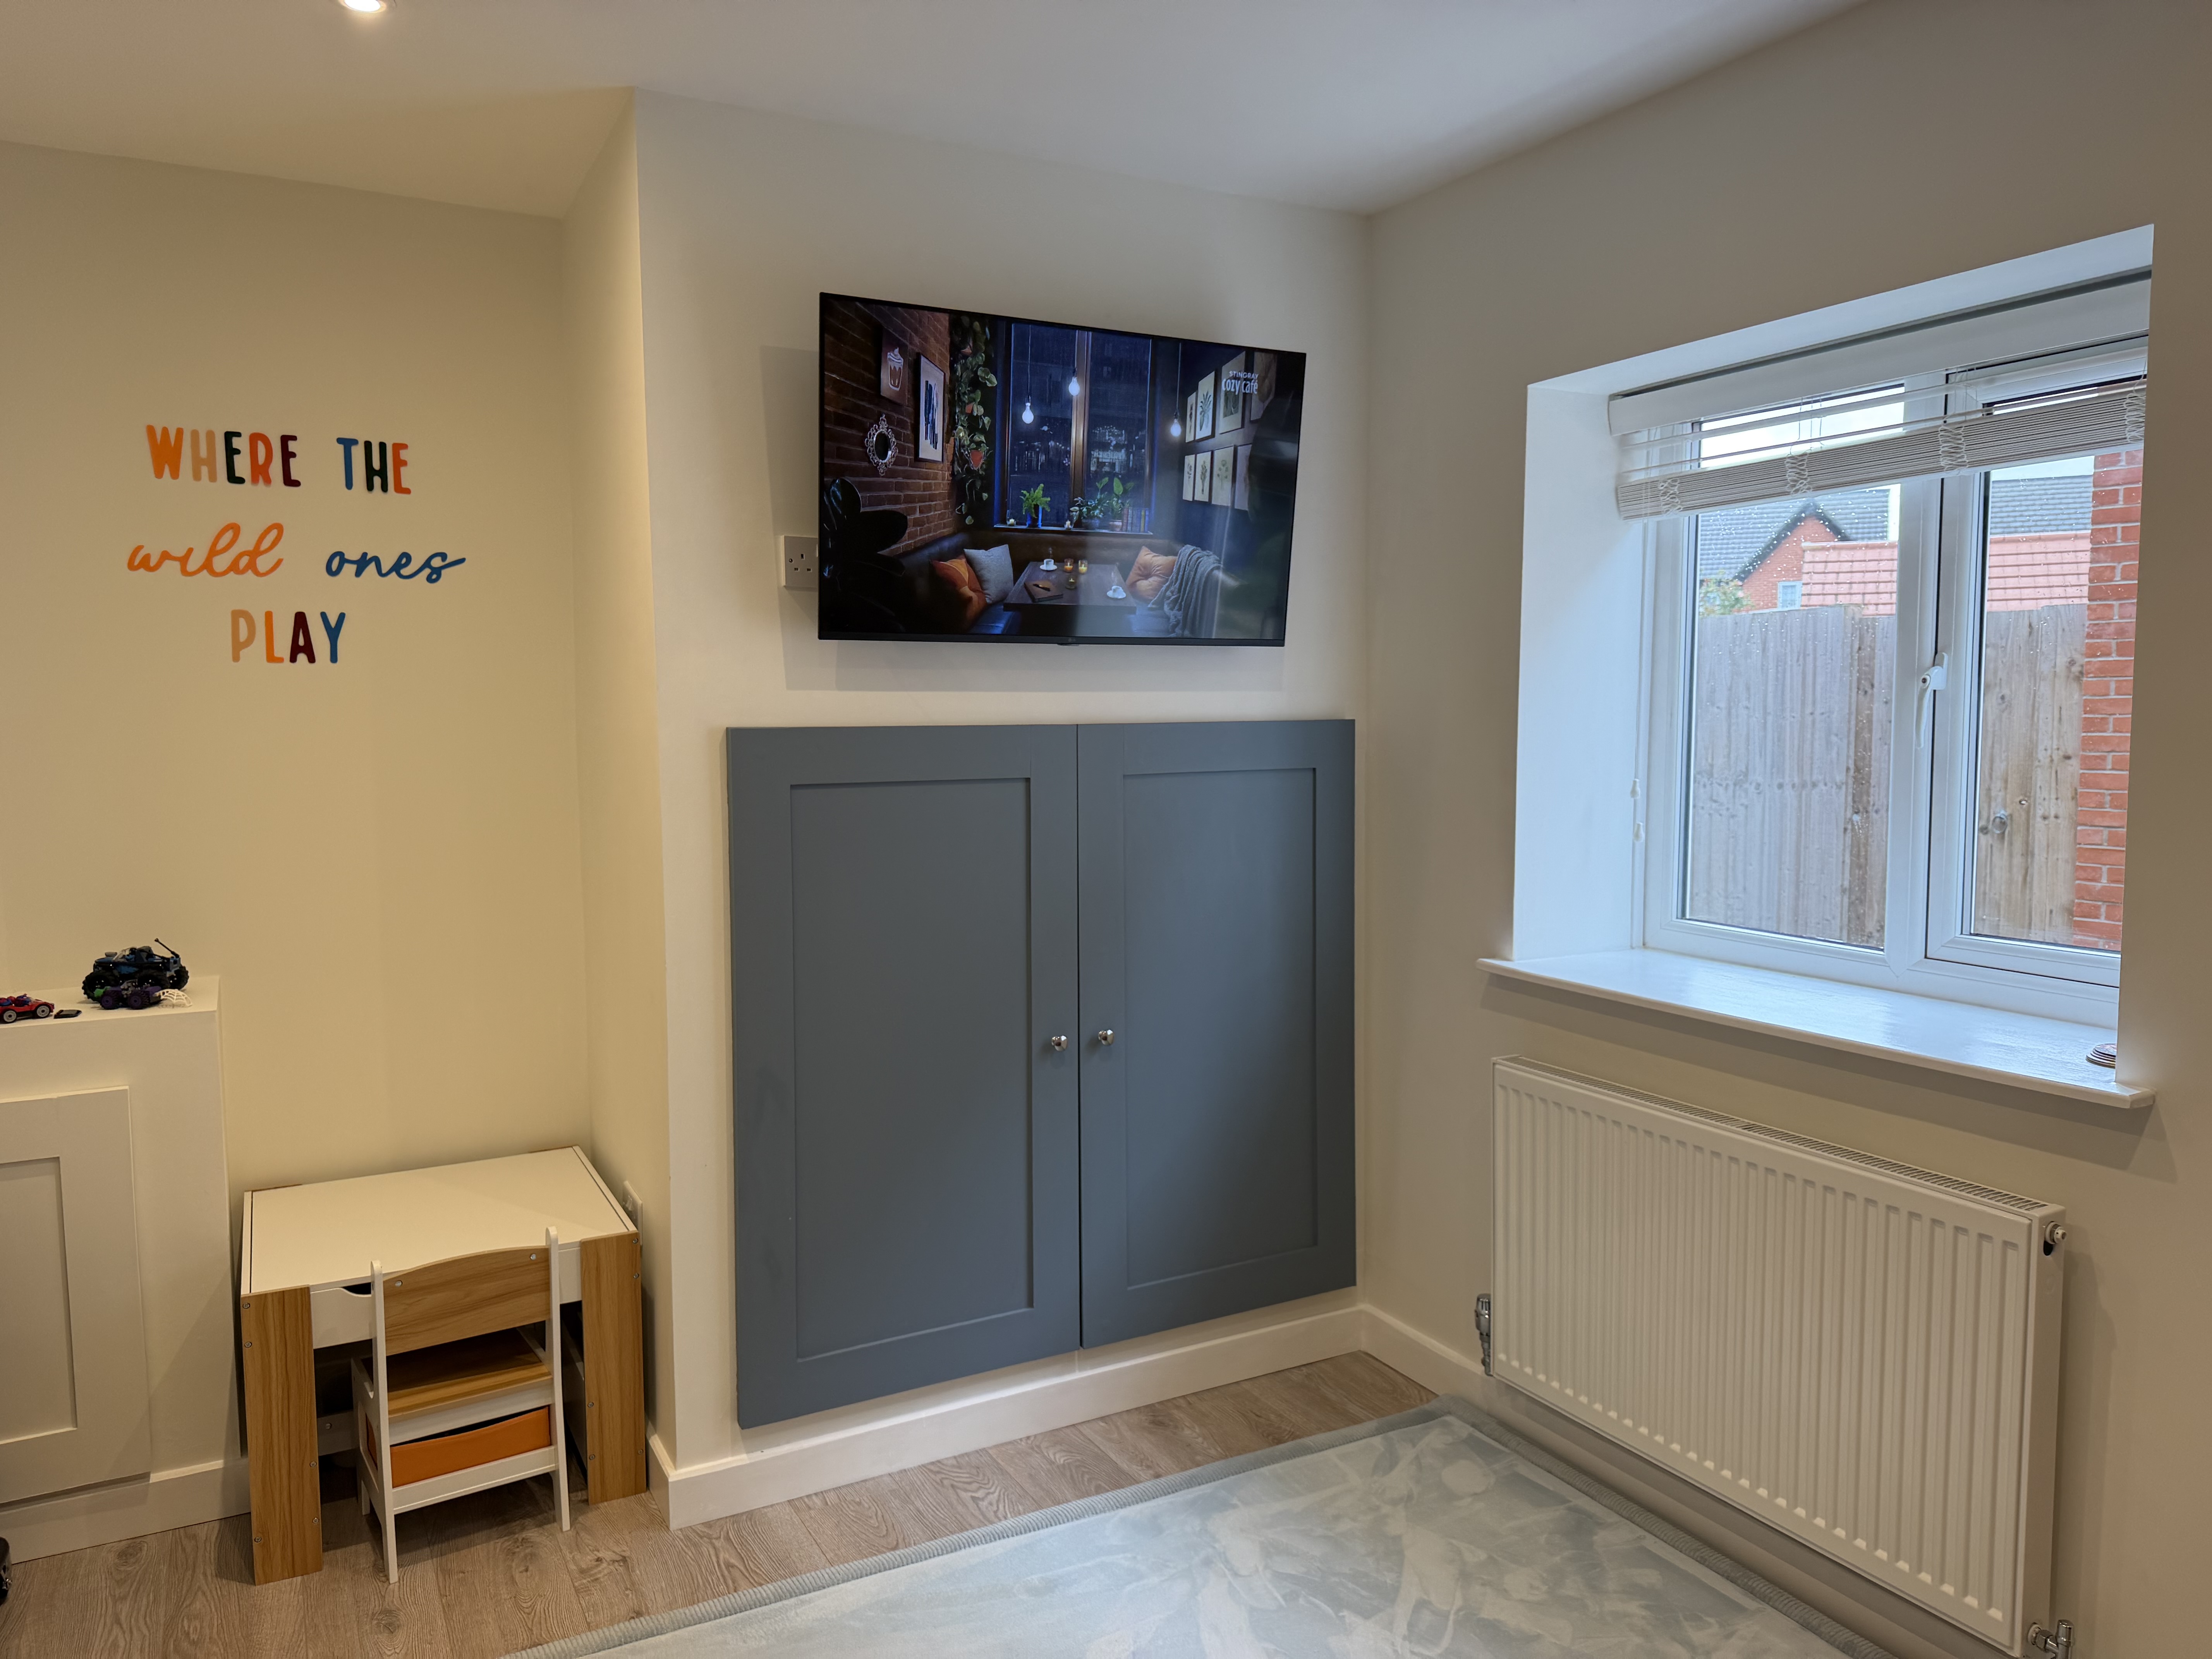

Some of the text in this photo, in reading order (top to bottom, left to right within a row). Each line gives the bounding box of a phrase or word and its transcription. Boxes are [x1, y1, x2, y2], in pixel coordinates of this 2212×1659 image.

[1242, 380, 1258, 394] café
[146, 424, 412, 495] WHERE THE
[127, 522, 466, 584] wild ones
[230, 609, 346, 664] PLAY
